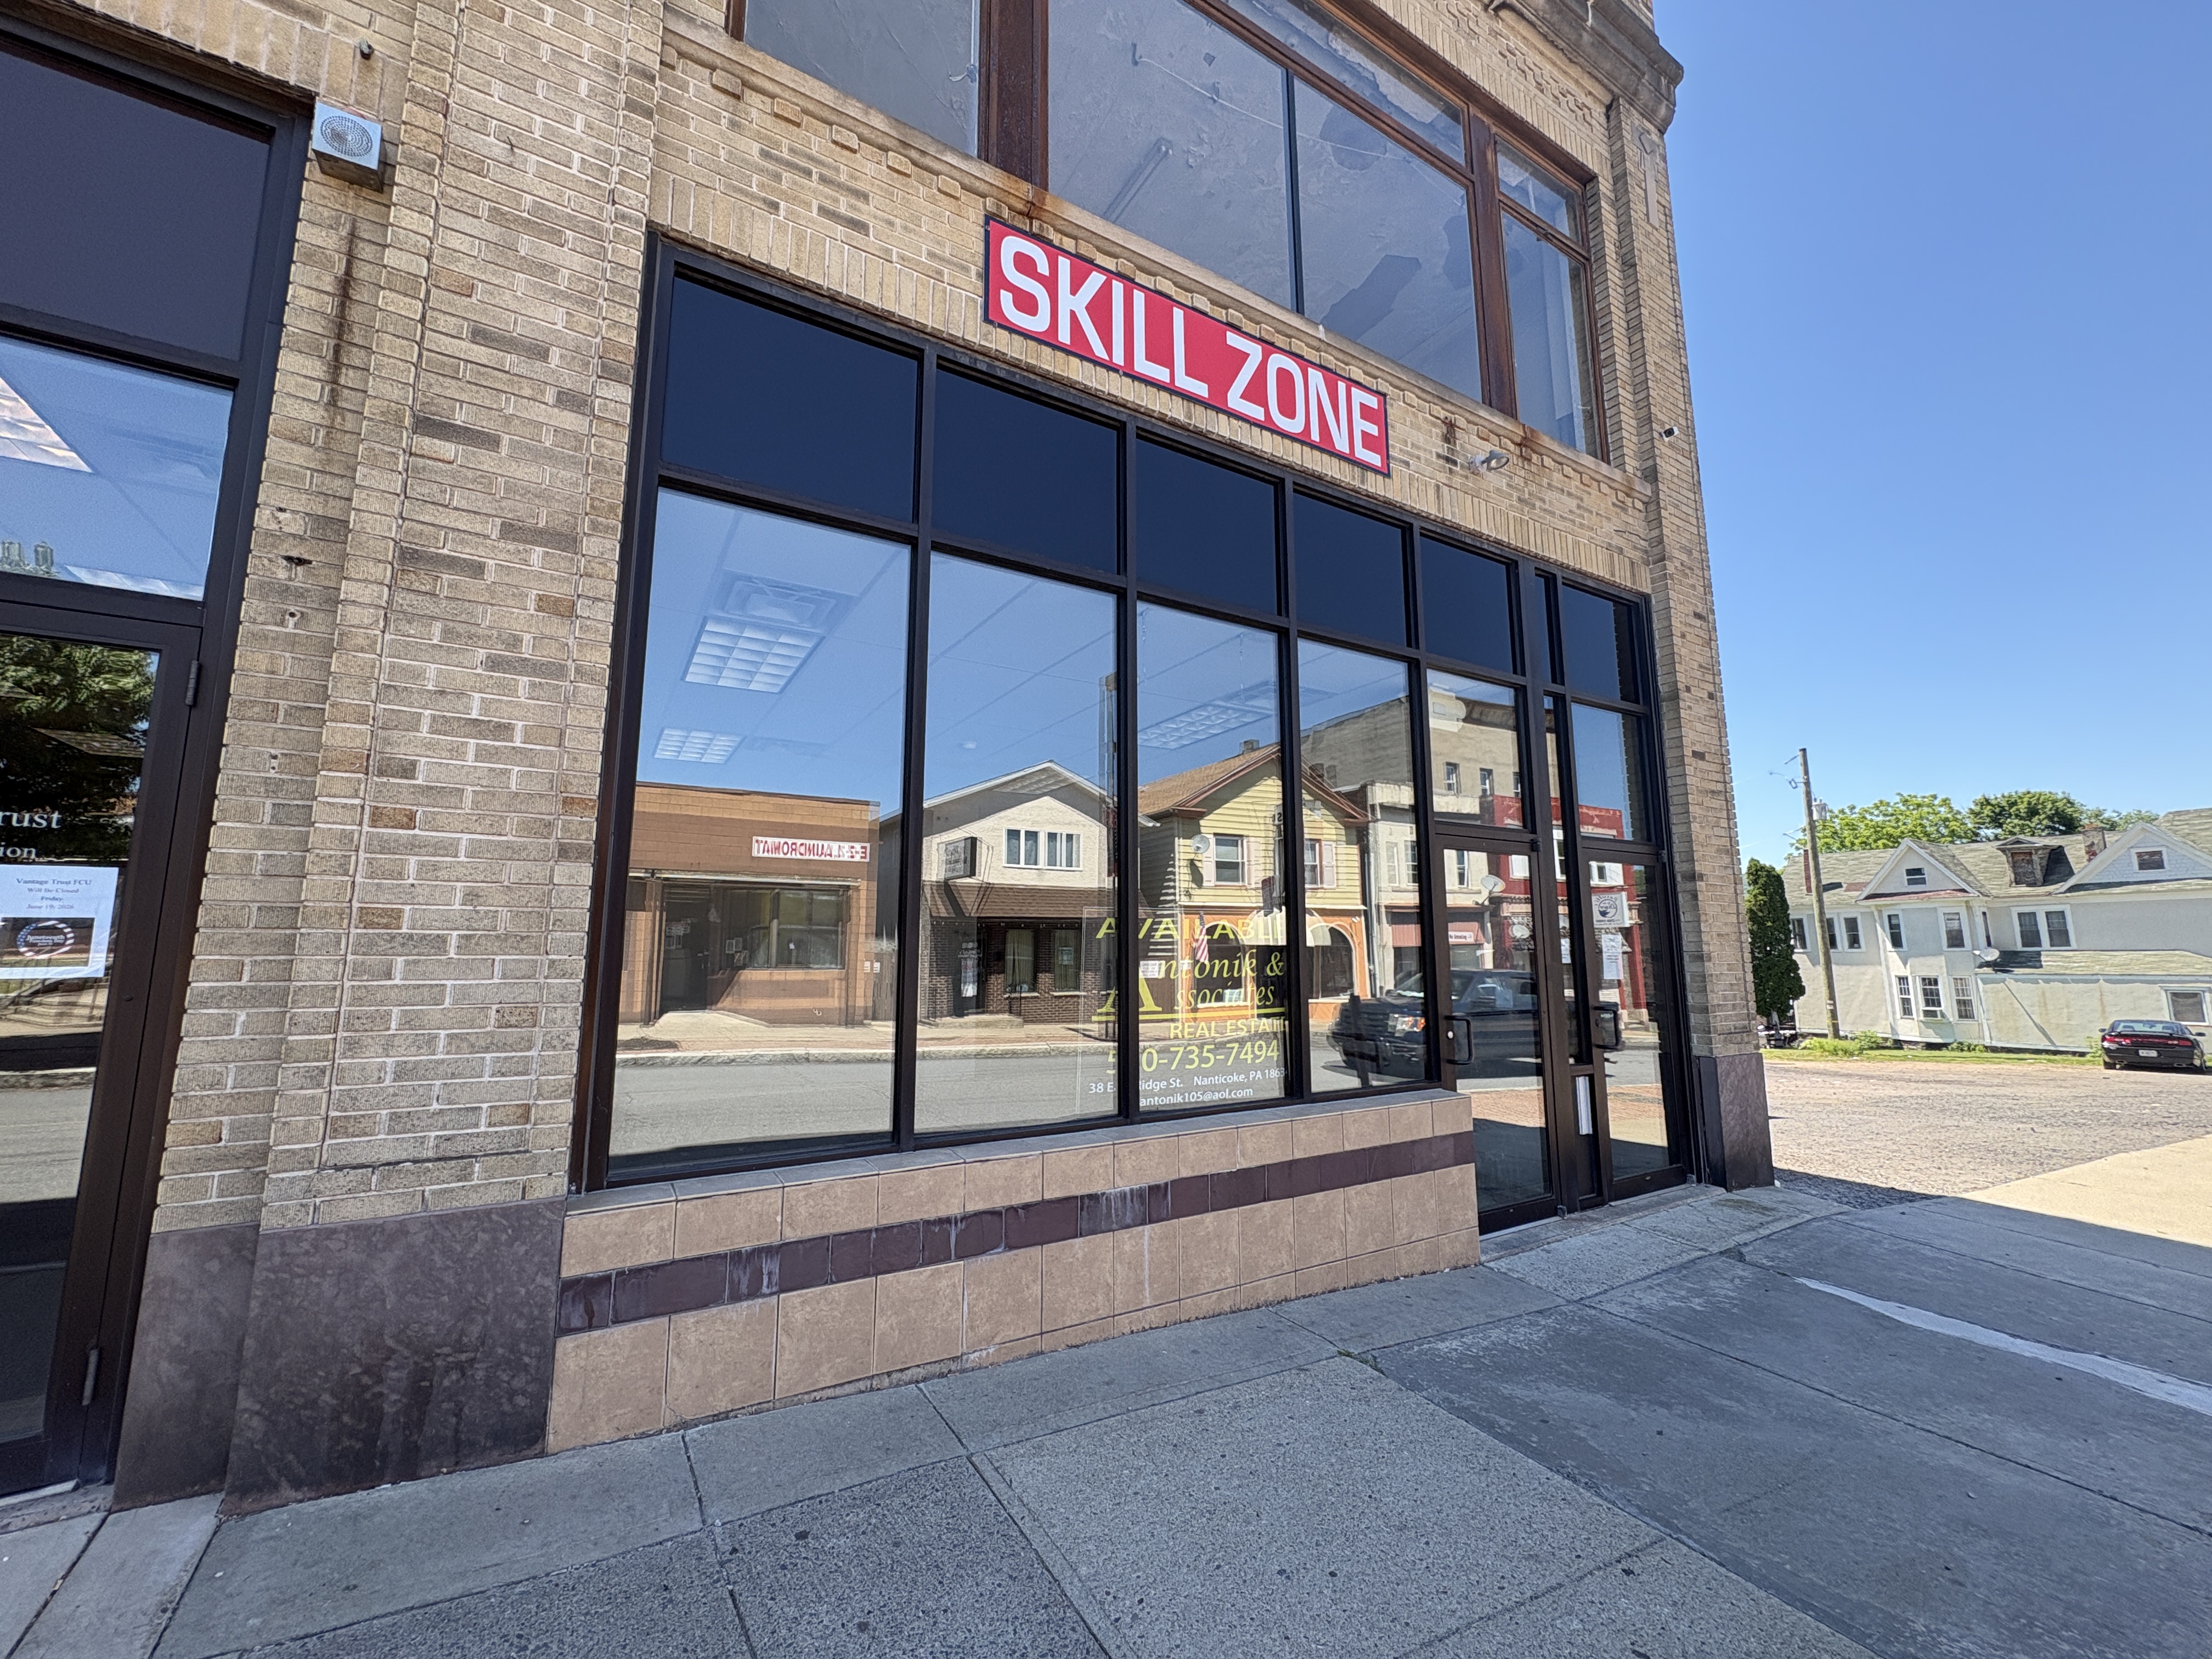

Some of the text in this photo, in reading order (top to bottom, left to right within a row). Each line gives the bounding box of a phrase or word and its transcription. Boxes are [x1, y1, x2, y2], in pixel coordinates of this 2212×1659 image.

[1000, 235, 1383, 467] SKILL ZONE
[1266, 952, 1284, 977] &
[1170, 1022, 1221, 1039] REAL
[1106, 1040, 1280, 1074] 50-735-7494
[1089, 1082, 1104, 1093] 38
[1170, 1077, 1183, 1087] St.
[1194, 1073, 1247, 1086] Nanticoke,
[1250, 1070, 1262, 1081] PA
[1265, 1067, 1288, 1079] 1863
